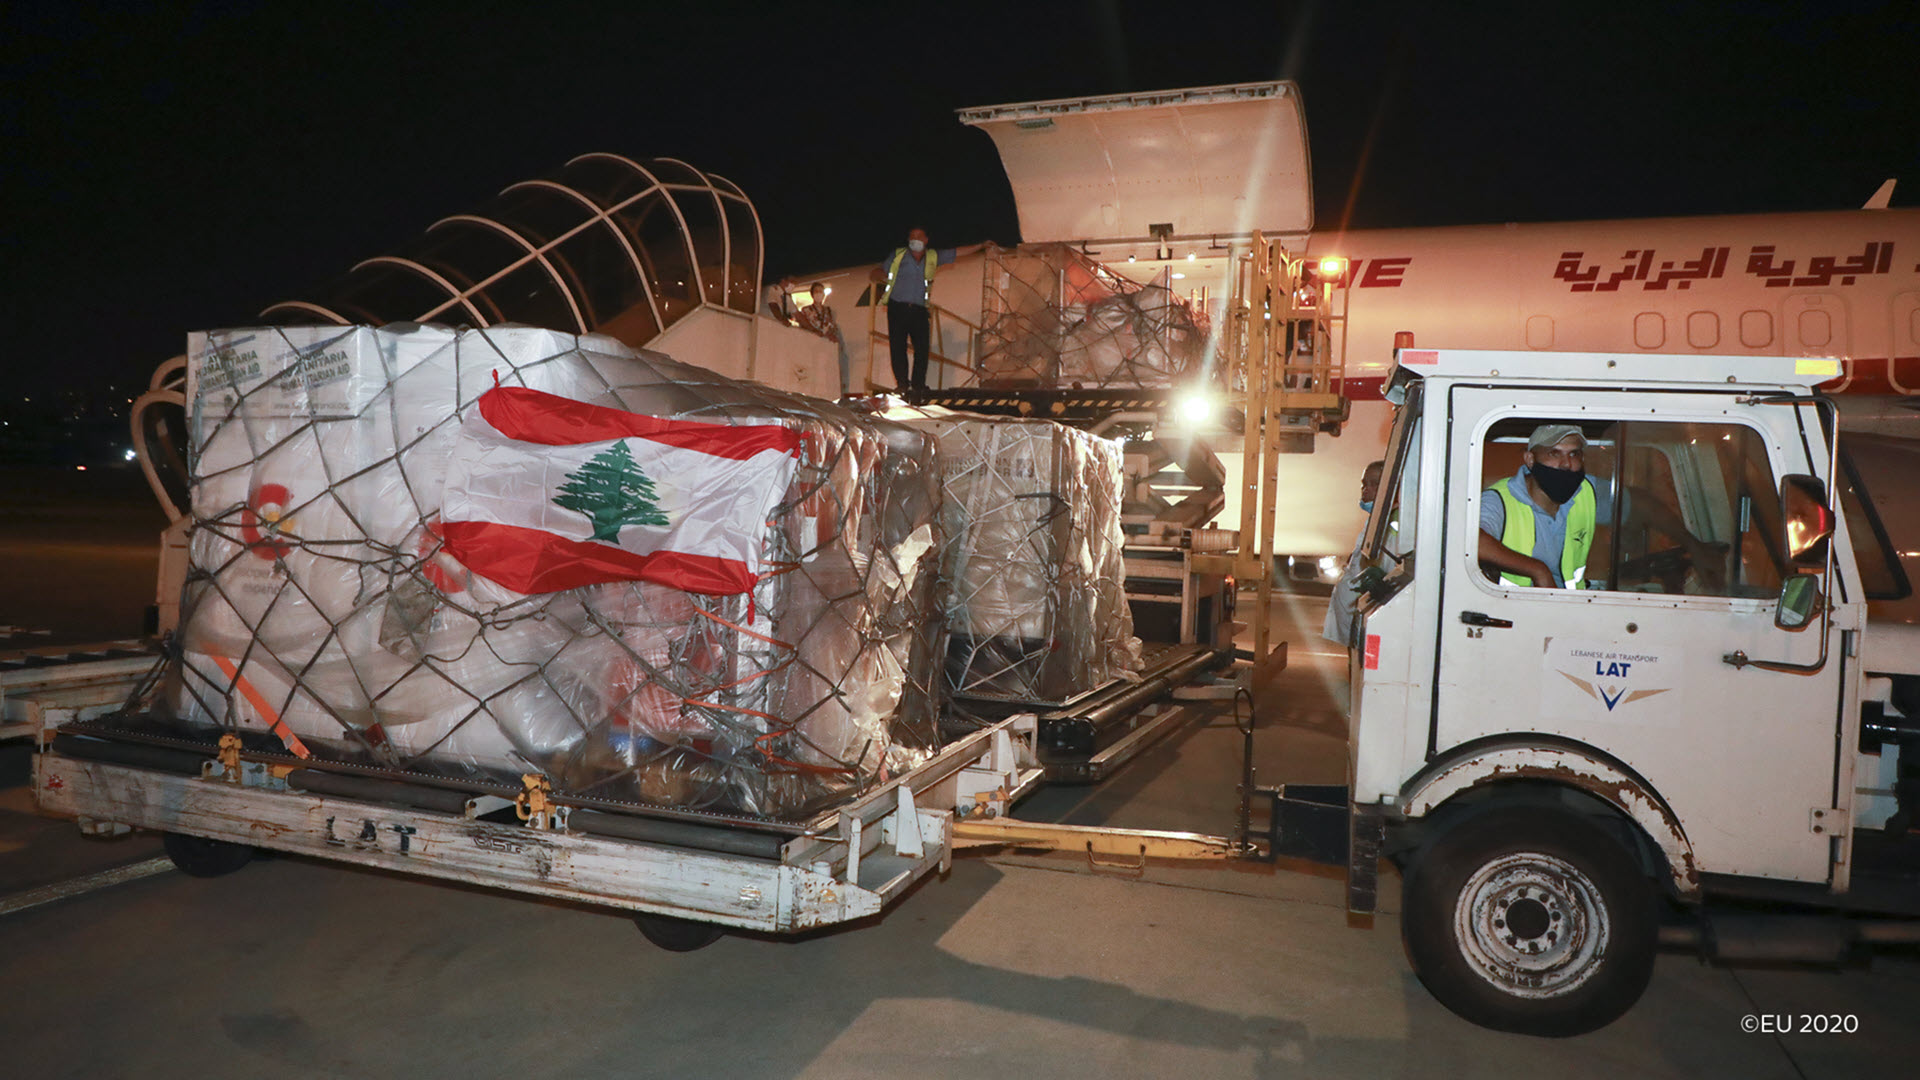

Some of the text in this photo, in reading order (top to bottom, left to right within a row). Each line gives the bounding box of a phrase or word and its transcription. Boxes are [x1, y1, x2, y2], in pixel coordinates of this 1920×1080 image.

[1553, 242, 1895, 292] الجوية الجزائرية
[195, 350, 258, 378] HUMAITARIA
[1570, 649, 1659, 663] LEBANESE AIR TRANSPORT
[1595, 660, 1632, 678] LAT
